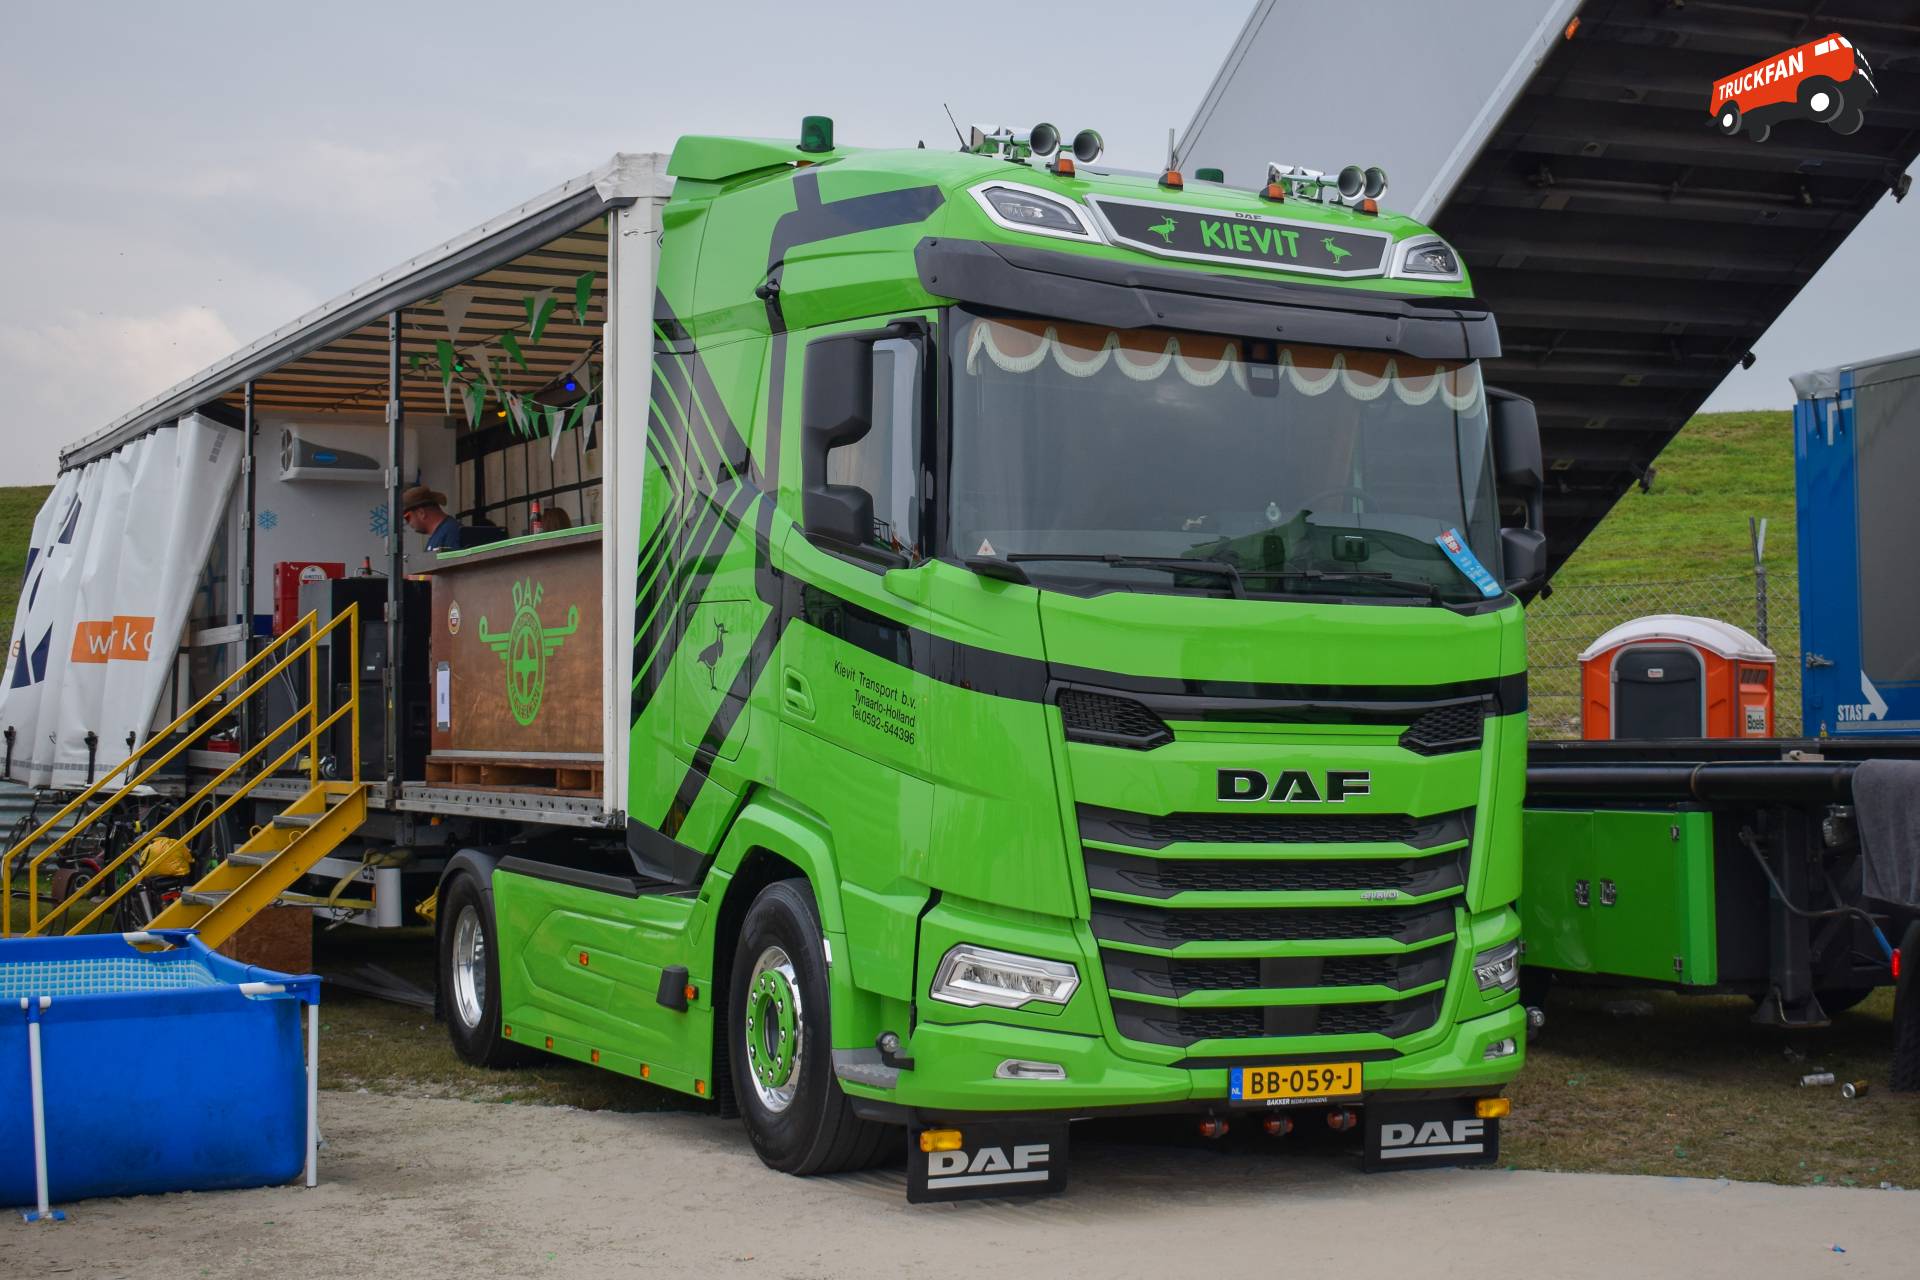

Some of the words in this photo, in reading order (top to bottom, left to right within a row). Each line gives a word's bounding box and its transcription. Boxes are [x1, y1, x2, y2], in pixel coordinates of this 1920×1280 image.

[1235, 212, 1262, 220] DAF
[1200, 219, 1299, 258] KIEVIT
[512, 575, 545, 612] DAF
[834, 659, 856, 682] Kievit
[859, 671, 898, 701] Transport
[901, 690, 917, 710] b.v.
[854, 688, 916, 727] Tynaarlo-Holland
[1837, 704, 1862, 721] STAS
[1217, 768, 1371, 802] DAF
[1231, 1087, 1241, 1095] NL
[1251, 1067, 1353, 1094] BB-059-J
[1266, 1098, 1290, 1106] BAKKER
[1380, 1119, 1484, 1147] DAF
[928, 1144, 1050, 1176] DAF
